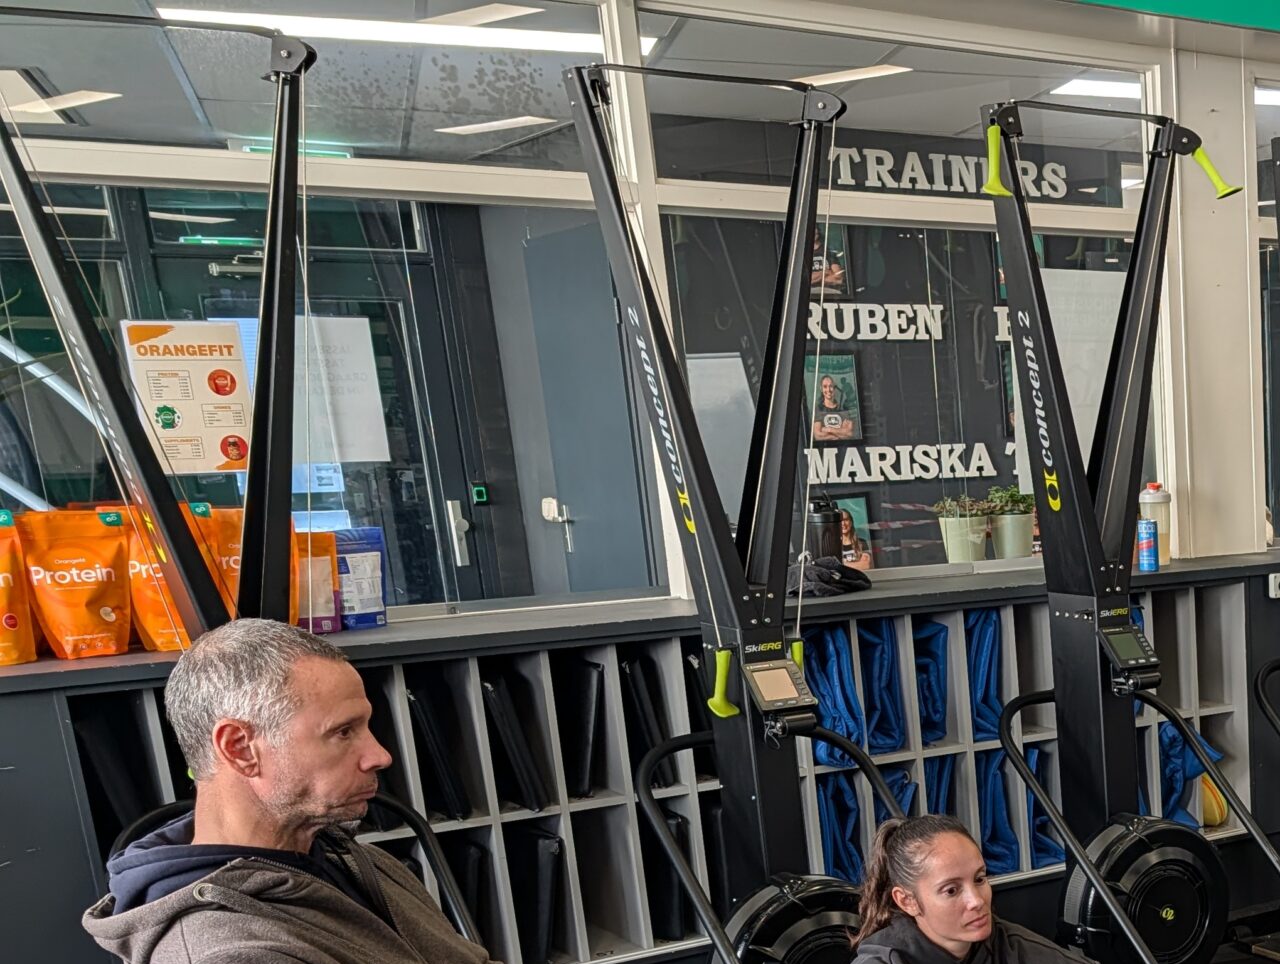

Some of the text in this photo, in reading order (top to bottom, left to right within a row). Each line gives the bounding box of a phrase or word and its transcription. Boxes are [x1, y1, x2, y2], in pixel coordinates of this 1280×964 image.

[828, 146, 1068, 199] TRAINRS
[807, 302, 944, 341] RUBEN
[136, 344, 234, 357] ORANGEFIT
[627, 305, 683, 485] concept 2
[1018, 310, 1053, 467] concept 2
[804, 442, 997, 485] MARISKA
[30, 564, 116, 586] Protein
[1099, 607, 1129, 618] SkiERG
[744, 641, 783, 654] SkiERG
